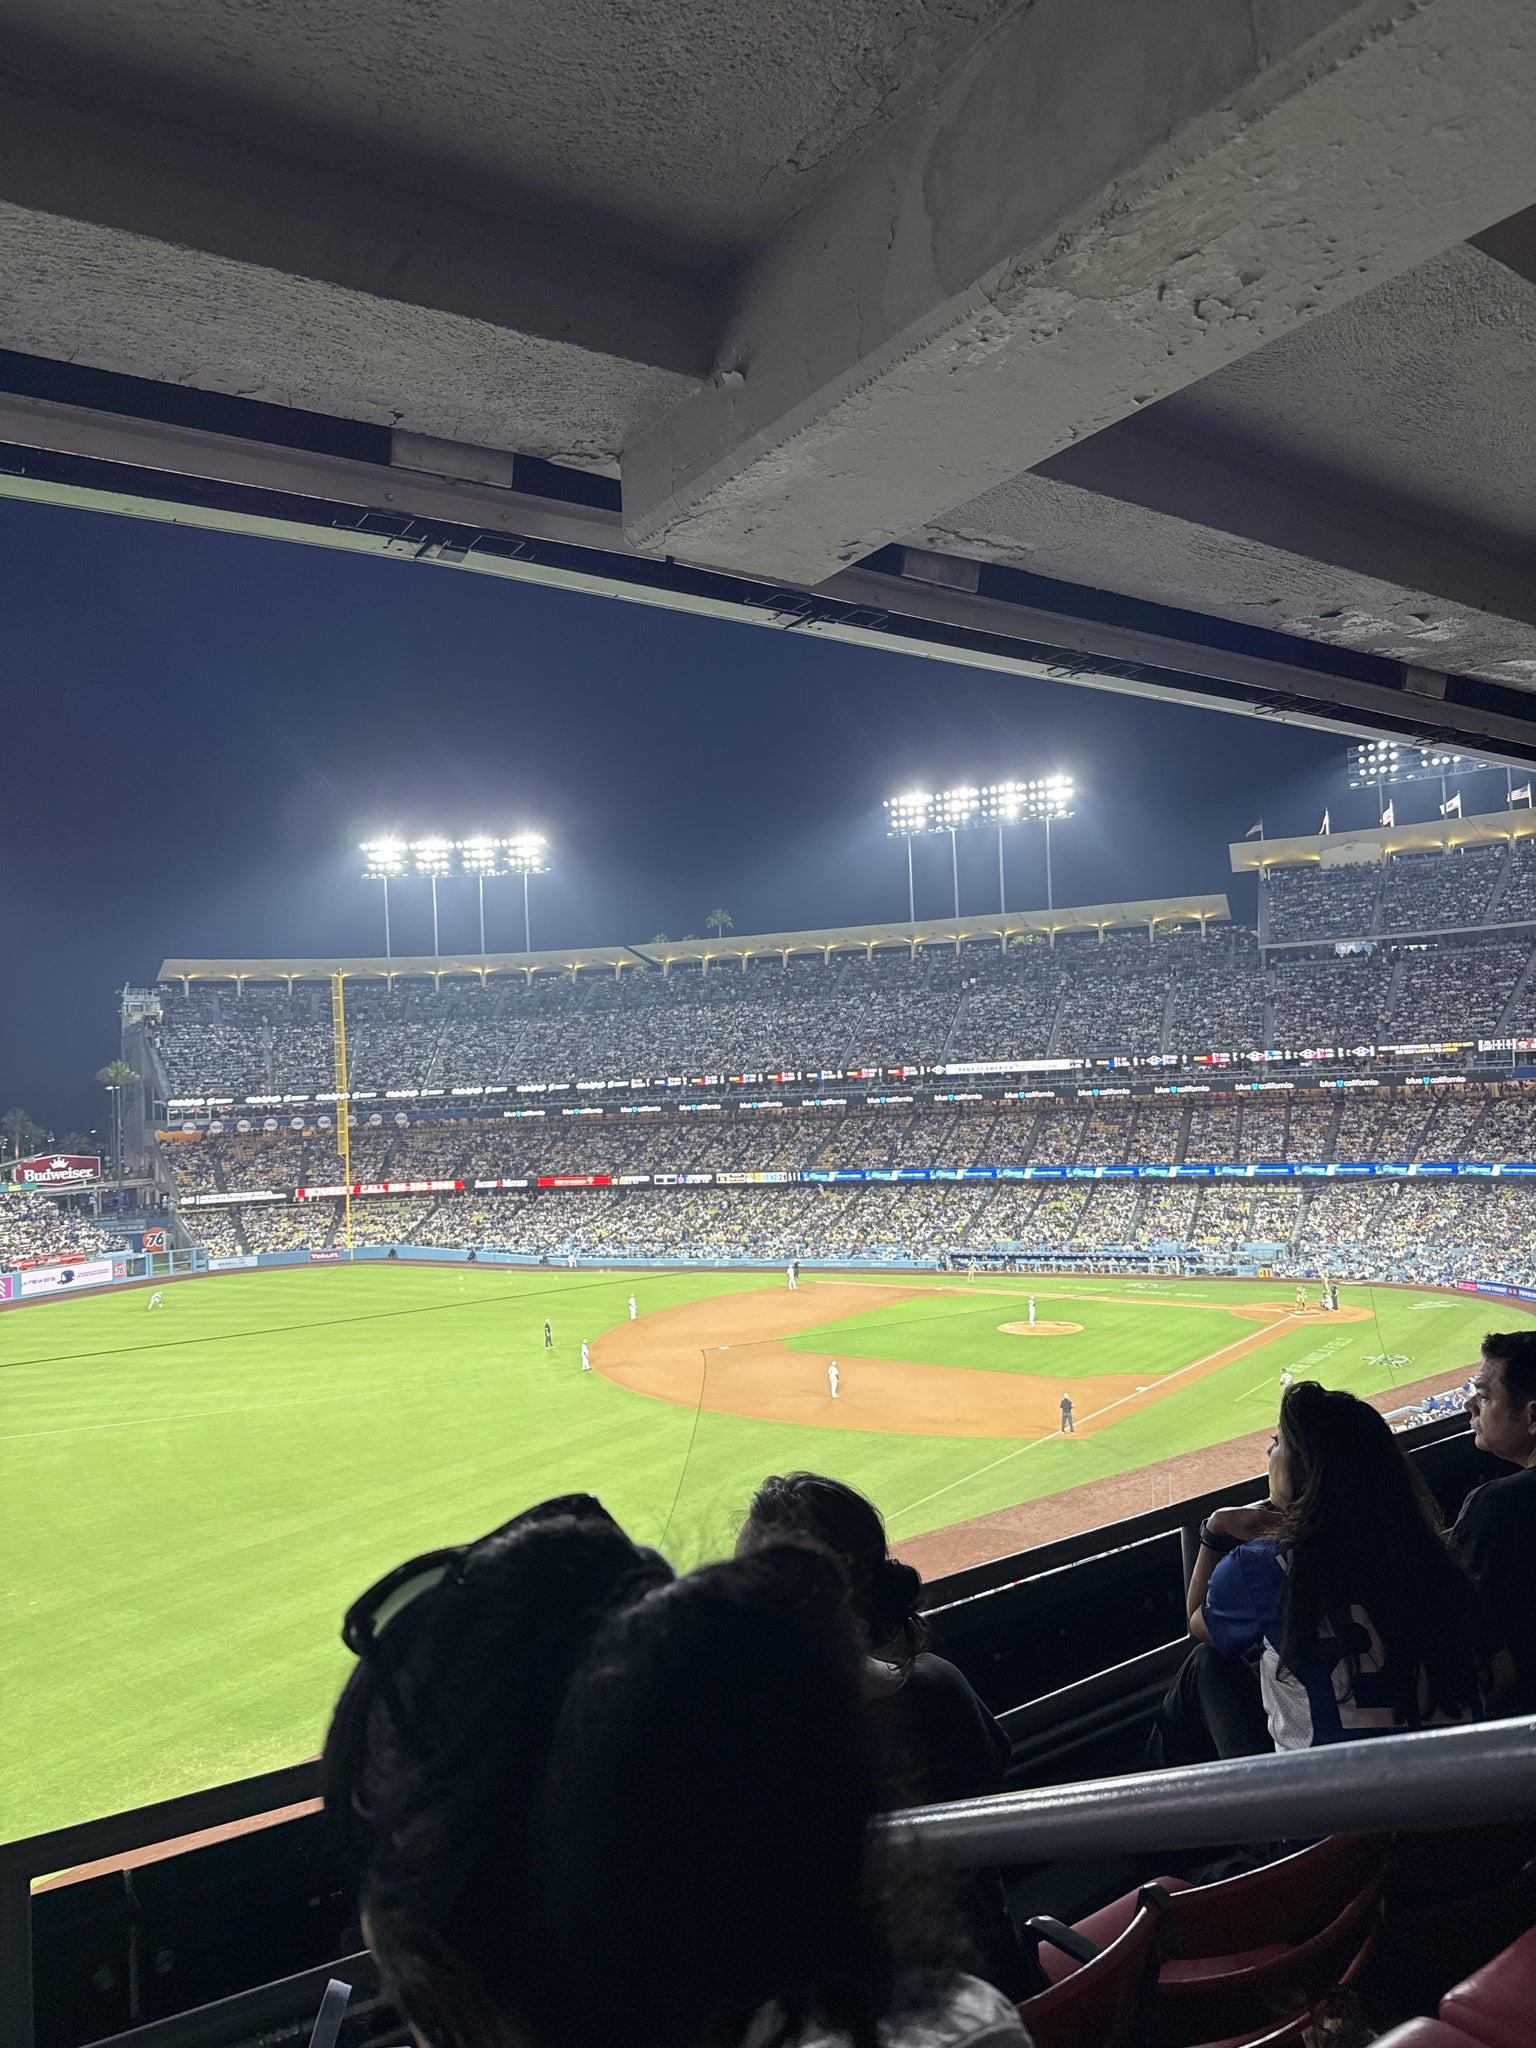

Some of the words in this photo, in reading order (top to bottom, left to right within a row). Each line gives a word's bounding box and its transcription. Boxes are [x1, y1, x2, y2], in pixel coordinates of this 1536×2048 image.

[1344, 1078, 1379, 1086] california
[1405, 1076, 1422, 1084] blue
[1430, 1075, 1465, 1084] california
[1177, 1084, 1210, 1093] california
[1259, 1081, 1293, 1090] california
[1025, 1090, 1055, 1098] california
[1099, 1088, 1130, 1096] california
[954, 1093, 982, 1101] california
[821, 1098, 846, 1106] california
[24, 1167, 94, 1182] Budweiser
[360, 1184, 386, 1194] CALL
[148, 1234, 164, 1247] 76
[311, 1251, 340, 1260] Yakult
[115, 1266, 124, 1274] 76
